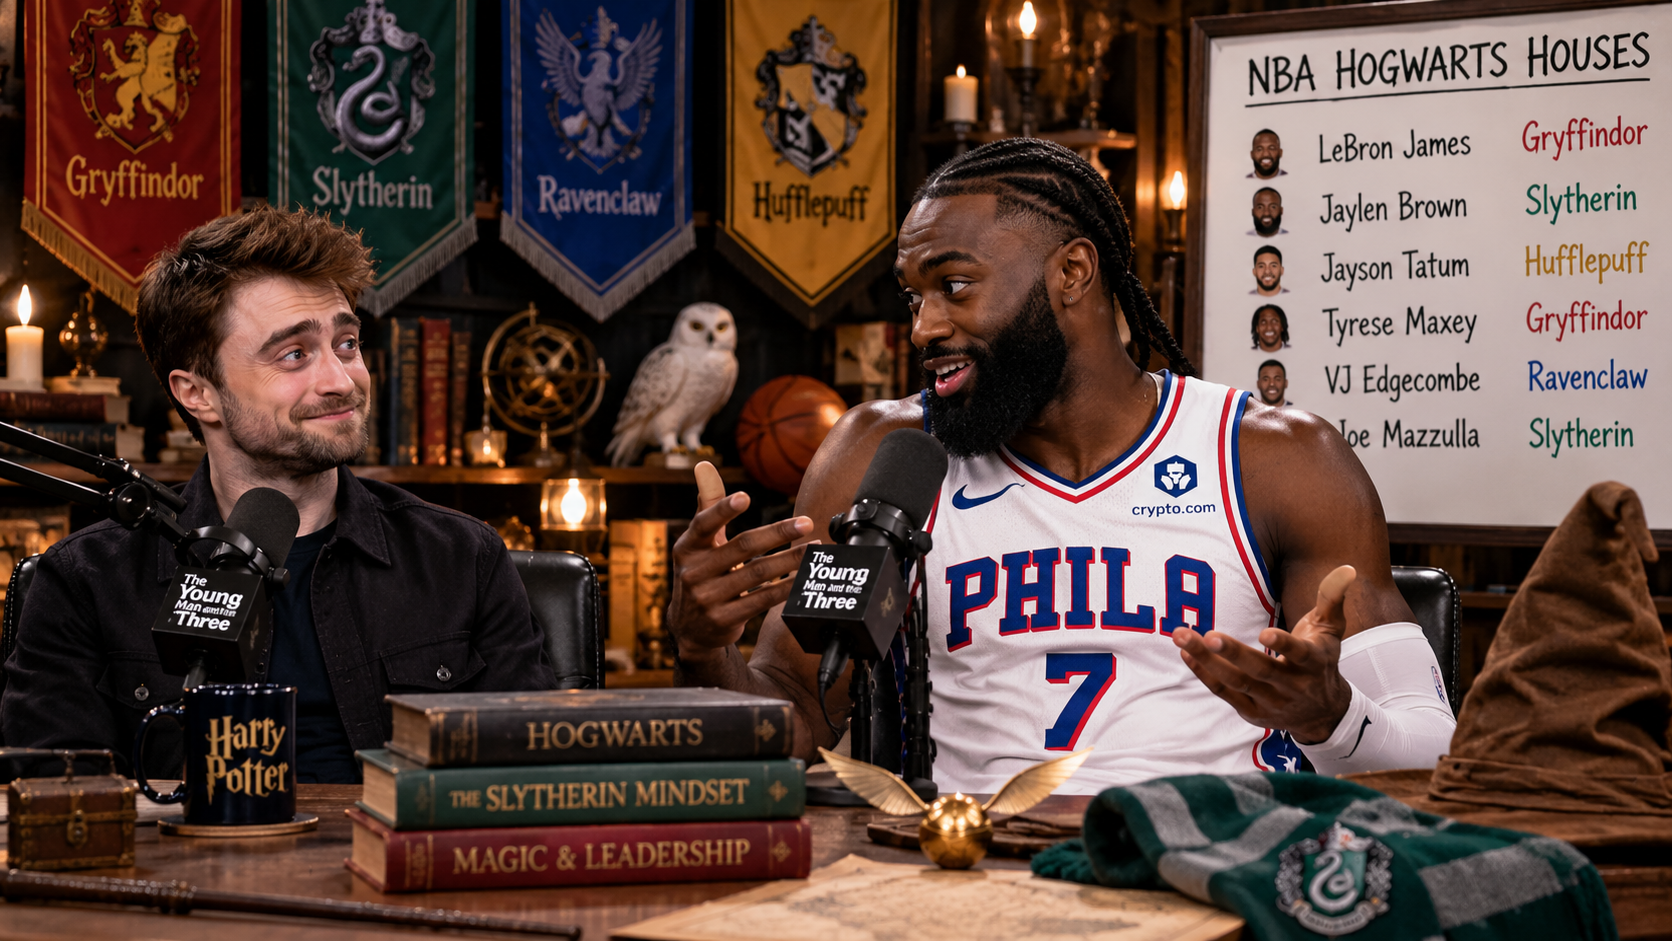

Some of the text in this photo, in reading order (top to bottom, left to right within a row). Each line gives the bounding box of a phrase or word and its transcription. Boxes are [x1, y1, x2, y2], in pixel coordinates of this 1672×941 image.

[1248, 31, 1651, 96] NBA HOGWARTS HOUSES
[1319, 129, 1472, 164] LeBron James
[1521, 115, 1648, 161] Gryffindor
[65, 154, 204, 206] Gryffindor
[312, 167, 434, 215] Slytherin
[536, 174, 662, 221] Ravenclaw
[752, 181, 871, 227] Hufflepuff
[1320, 191, 1467, 232] Jaylen Brown
[1525, 183, 1637, 225] Slytherin
[1321, 249, 1470, 291] Jayson Tatum
[1525, 241, 1650, 284] Hufflepuff
[1322, 306, 1477, 347] Tyrese Maxey
[1525, 300, 1648, 342] Gryffindor
[1325, 362, 1481, 402] VJ Edgecombe
[1528, 359, 1648, 391] Ravenclaw
[1383, 418, 1480, 449] Mazzulla
[1529, 417, 1634, 458] Slytherin
[1132, 502, 1216, 517] crypto.com
[809, 563, 869, 585] Young
[813, 552, 834, 563] The
[180, 584, 243, 609] Young
[184, 573, 207, 586] The
[946, 546, 1216, 653] PHILA
[173, 610, 230, 631] Three
[175, 600, 202, 612] Man
[801, 591, 857, 610] Three
[1044, 652, 1117, 751] 7
[205, 714, 287, 761] Harry
[526, 718, 704, 750] HOGWARTS
[205, 753, 289, 806] Potter
[449, 779, 750, 812] THE SLYTHERIN MINDSET
[452, 838, 751, 875] MAGIC & LEADERSHIP
